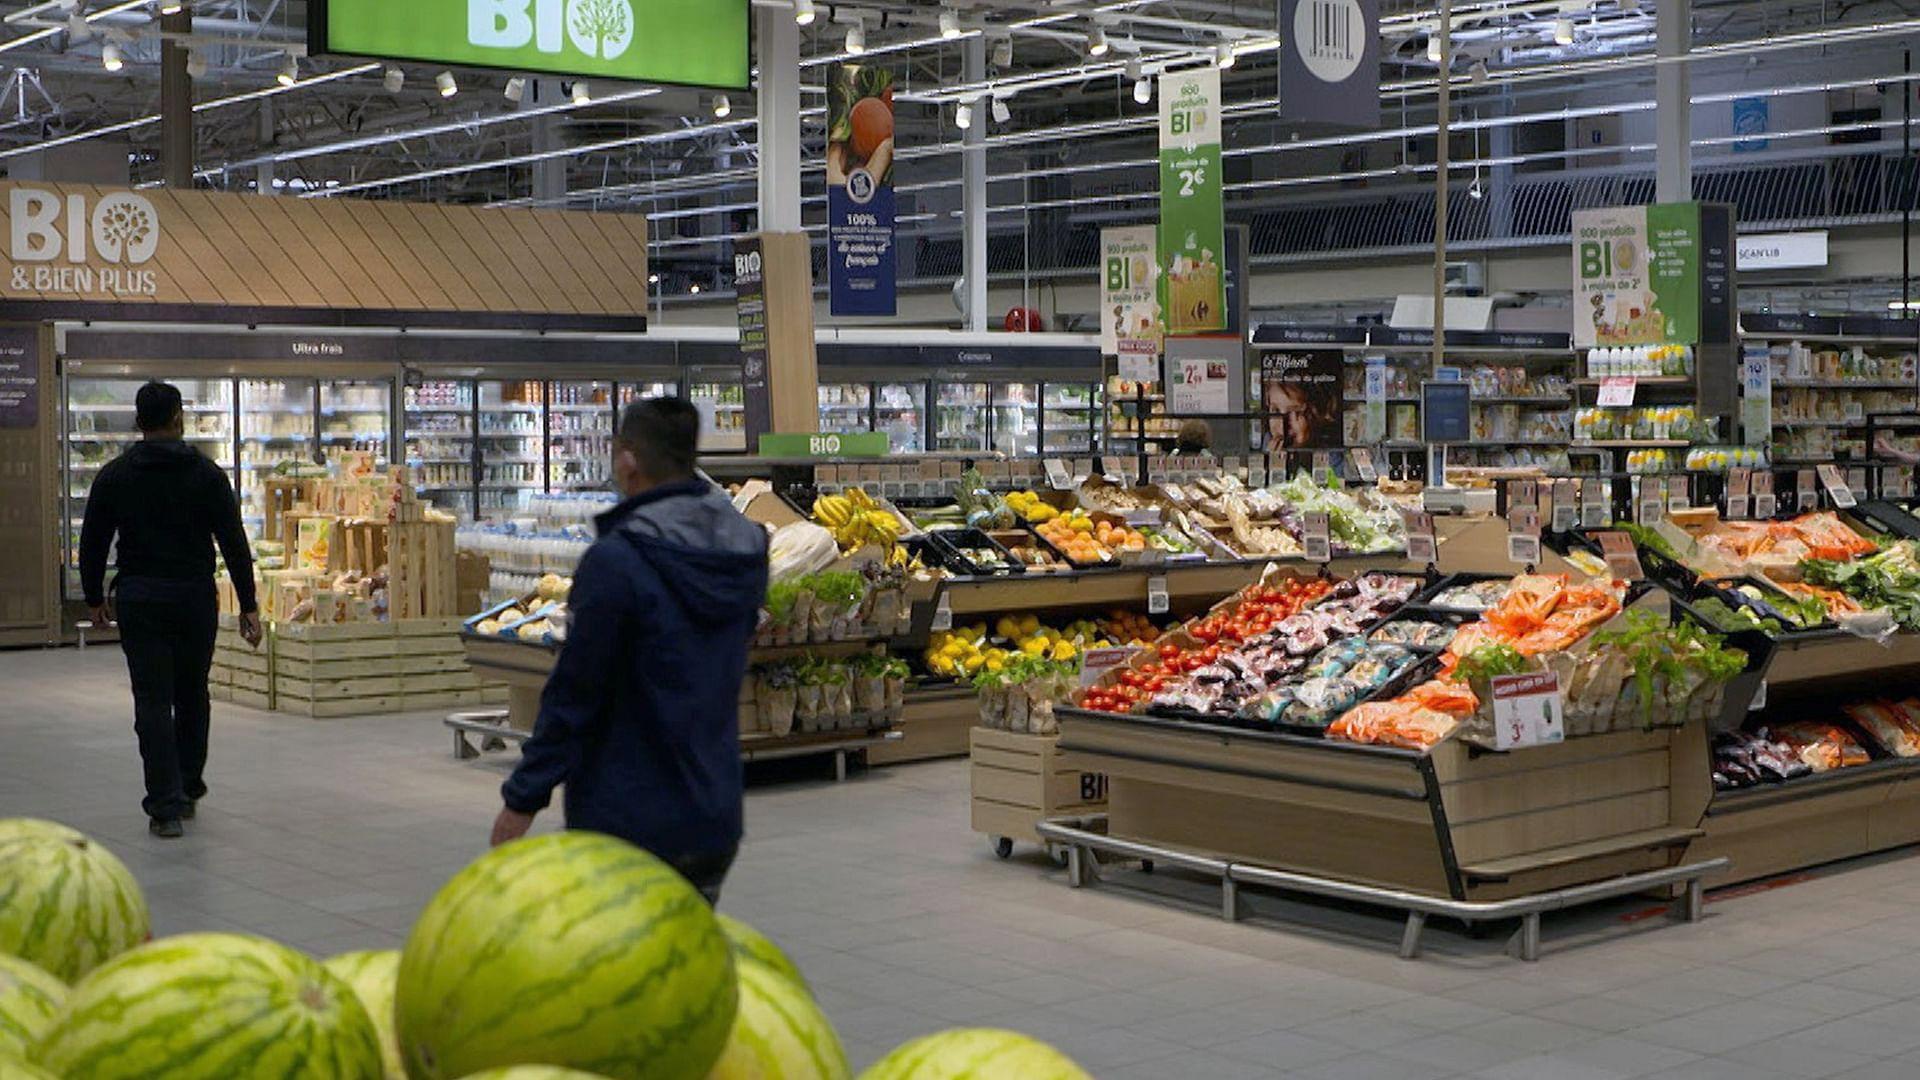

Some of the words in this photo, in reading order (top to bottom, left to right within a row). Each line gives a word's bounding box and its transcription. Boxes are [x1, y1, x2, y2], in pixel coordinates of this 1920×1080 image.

[467, 0, 634, 60] BIO
[10, 188, 160, 264] BIO
[847, 213, 877, 226] 100%
[735, 251, 761, 276] BIO
[11, 266, 31, 290] &
[100, 268, 157, 296] PLUS
[292, 343, 319, 355] Ultra
[320, 343, 344, 355] frais
[809, 434, 841, 455] BIO
